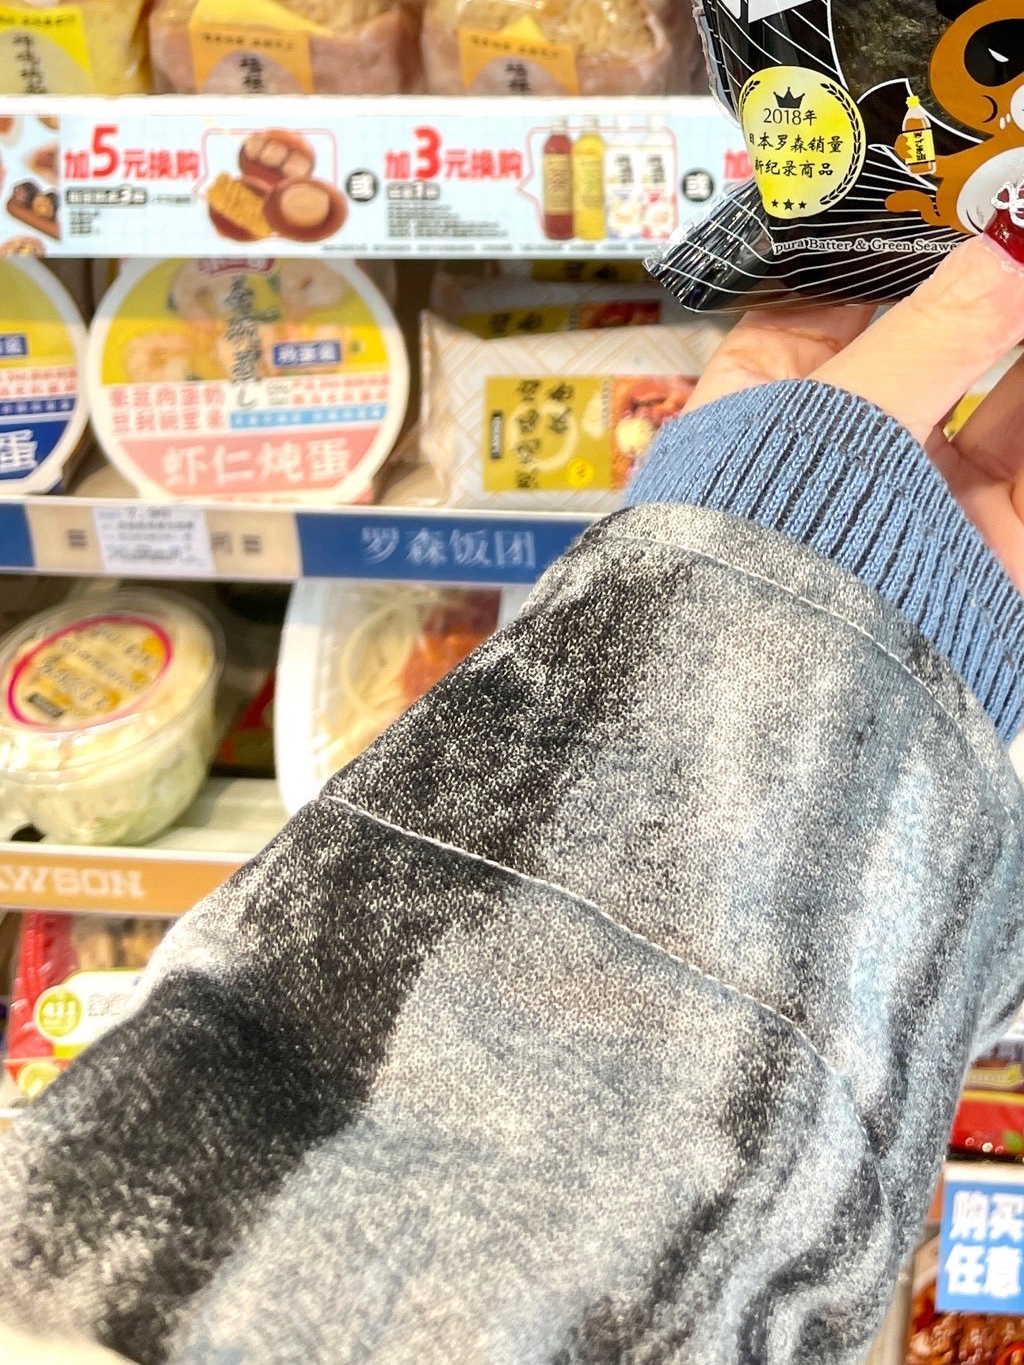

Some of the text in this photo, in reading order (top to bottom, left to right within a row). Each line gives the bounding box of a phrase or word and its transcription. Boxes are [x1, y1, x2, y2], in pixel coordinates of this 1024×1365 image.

[762, 107, 818, 126] 2018年
[65, 124, 199, 180] 加5元换购
[385, 125, 523, 181] 加3元换购
[748, 130, 844, 155] 日本罗森销量
[754, 157, 835, 178] 新纪录商品
[808, 237, 851, 252] Batter
[854, 238, 868, 251] &
[870, 237, 911, 253] Green
[161, 436, 350, 488] 虾仁炖蛋
[361, 525, 537, 569] 罗森饭团
[0, 864, 146, 899] WSON
